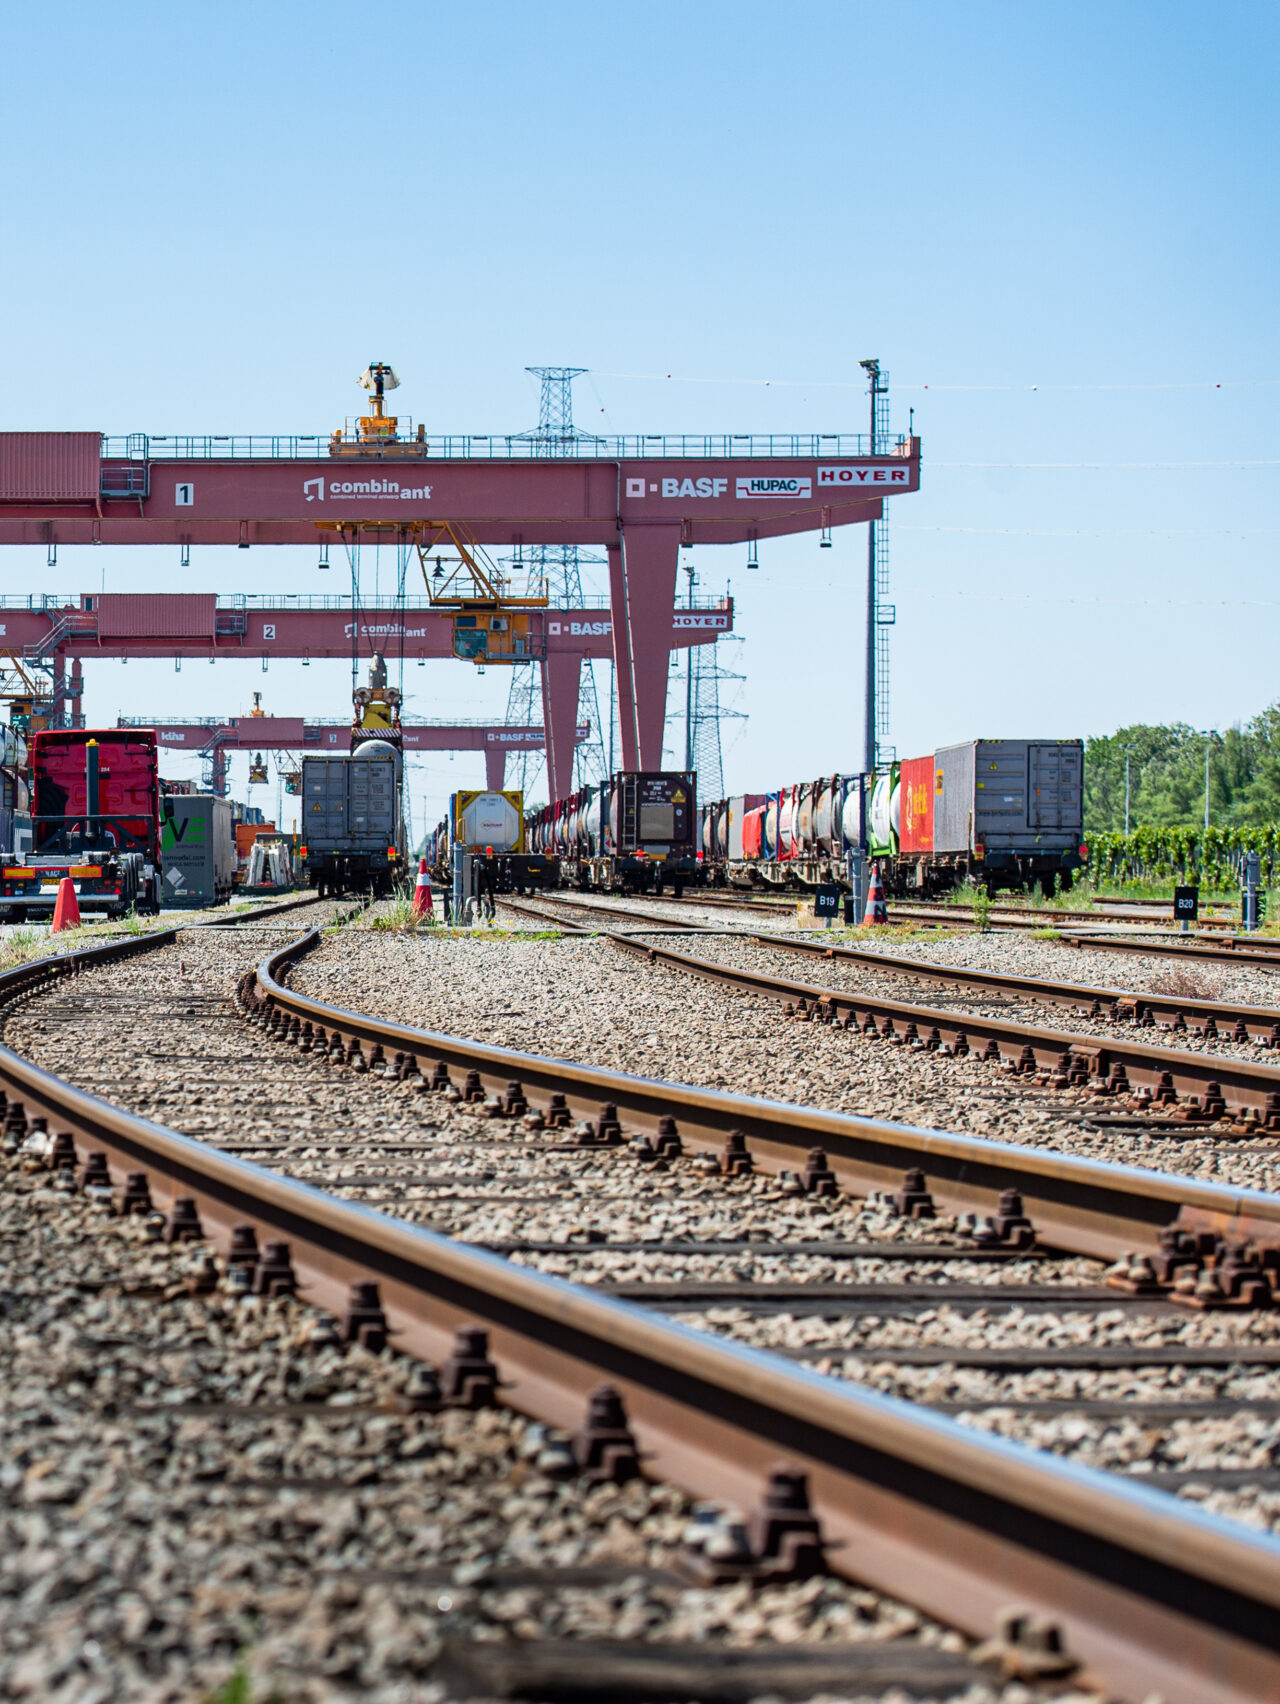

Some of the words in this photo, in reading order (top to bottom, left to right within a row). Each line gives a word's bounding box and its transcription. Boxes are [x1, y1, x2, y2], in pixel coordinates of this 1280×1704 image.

[821, 470, 906, 481] HOYER
[662, 478, 728, 498] BASF
[751, 480, 798, 492] HUPAC
[179, 485, 189, 503] 1
[672, 618, 726, 626] HOYER
[265, 626, 274, 638] 2
[570, 622, 612, 635] BASF
[500, 733, 524, 741] BASF
[819, 895, 835, 906] B19
[1178, 898, 1194, 909] B20
